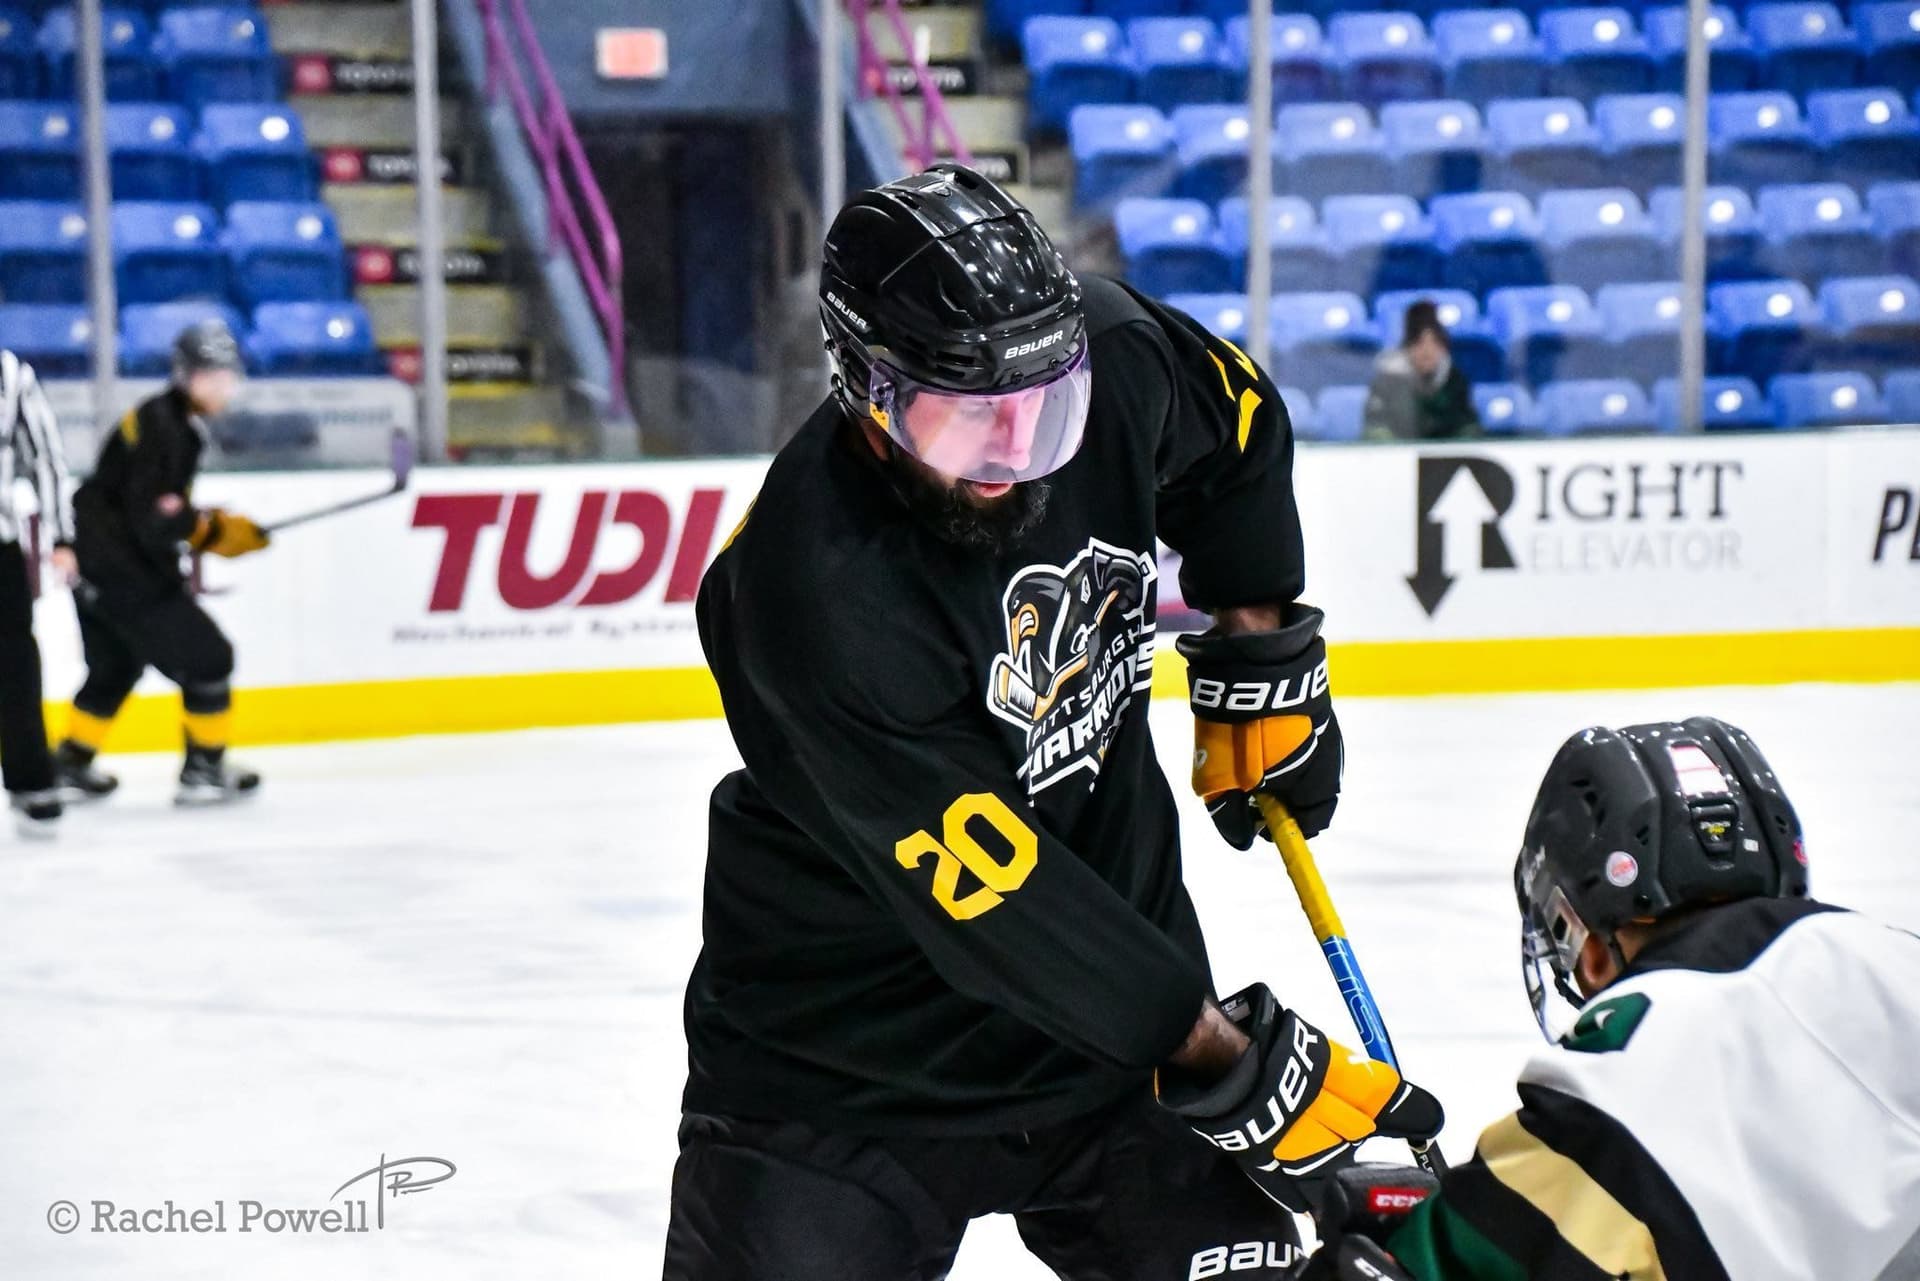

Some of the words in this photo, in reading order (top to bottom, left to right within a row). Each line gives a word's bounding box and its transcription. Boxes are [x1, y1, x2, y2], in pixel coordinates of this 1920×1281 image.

[412, 489, 726, 612] TUDI
[1531, 530, 1743, 570] ELEVATOR
[1191, 658, 1328, 711] BAUE
[895, 792, 1038, 920] 20
[1208, 1017, 1319, 1152] AUER
